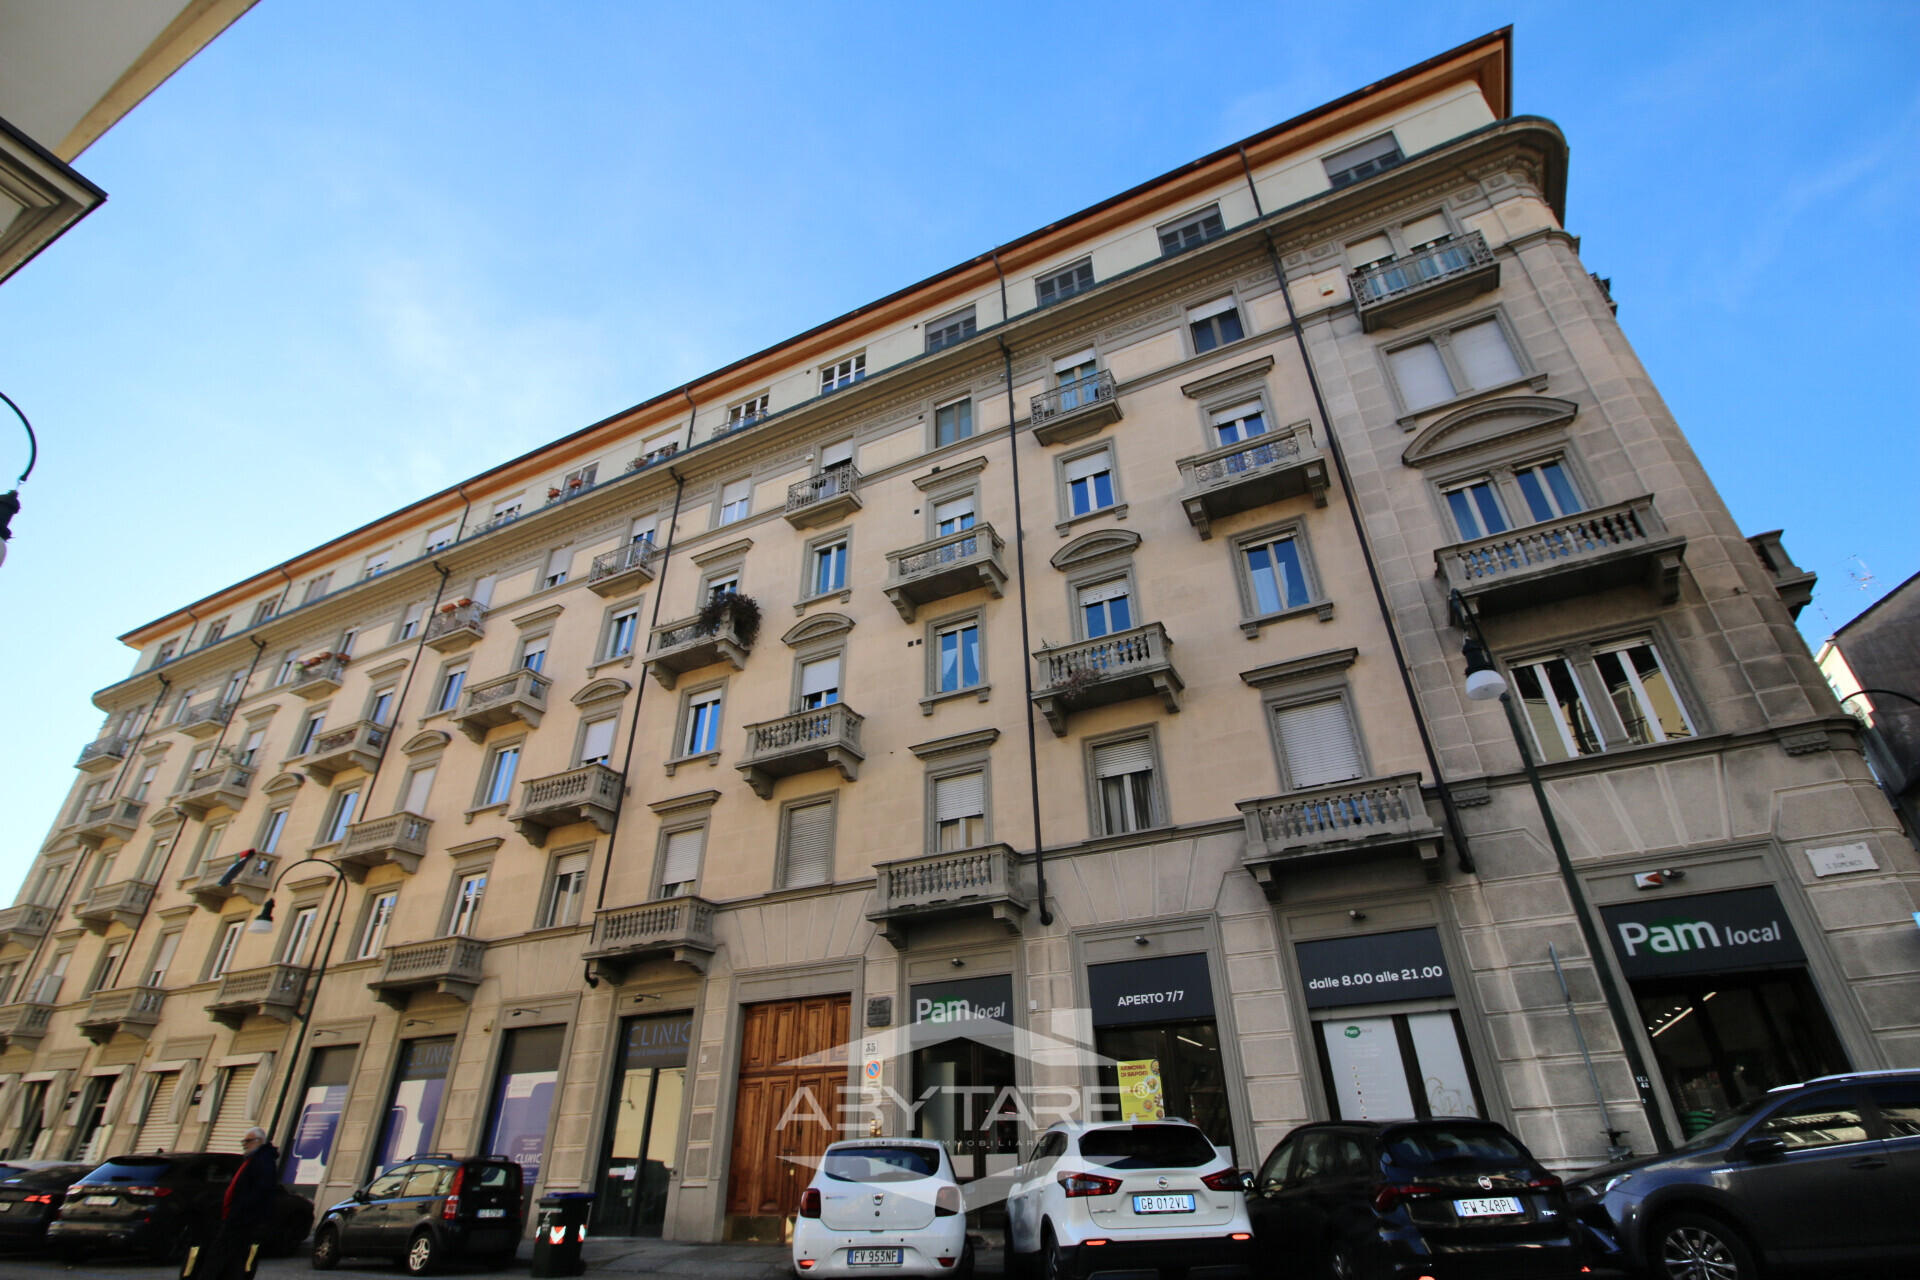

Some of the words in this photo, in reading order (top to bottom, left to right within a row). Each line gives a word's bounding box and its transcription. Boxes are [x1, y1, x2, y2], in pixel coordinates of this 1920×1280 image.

[1617, 921, 1722, 956] Pam
[1725, 920, 1781, 946] local
[1309, 977, 1339, 989] dalle
[1341, 973, 1373, 986] 8.00
[1375, 971, 1399, 982] alle
[1401, 966, 1443, 980] 21.00
[1117, 993, 1164, 1006] APERTO
[1165, 990, 1184, 1002] 7/7
[916, 998, 970, 1025] Pam
[973, 1001, 1006, 1019] local
[866, 1043, 876, 1053] 35
[1141, 1198, 1153, 1210] GB
[1156, 1197, 1188, 1209] 012VL
[1462, 1201, 1478, 1214] FW
[1480, 1199, 1516, 1213] 348PL
[855, 1251, 865, 1262] FV
[868, 1250, 897, 1262] 953NF
